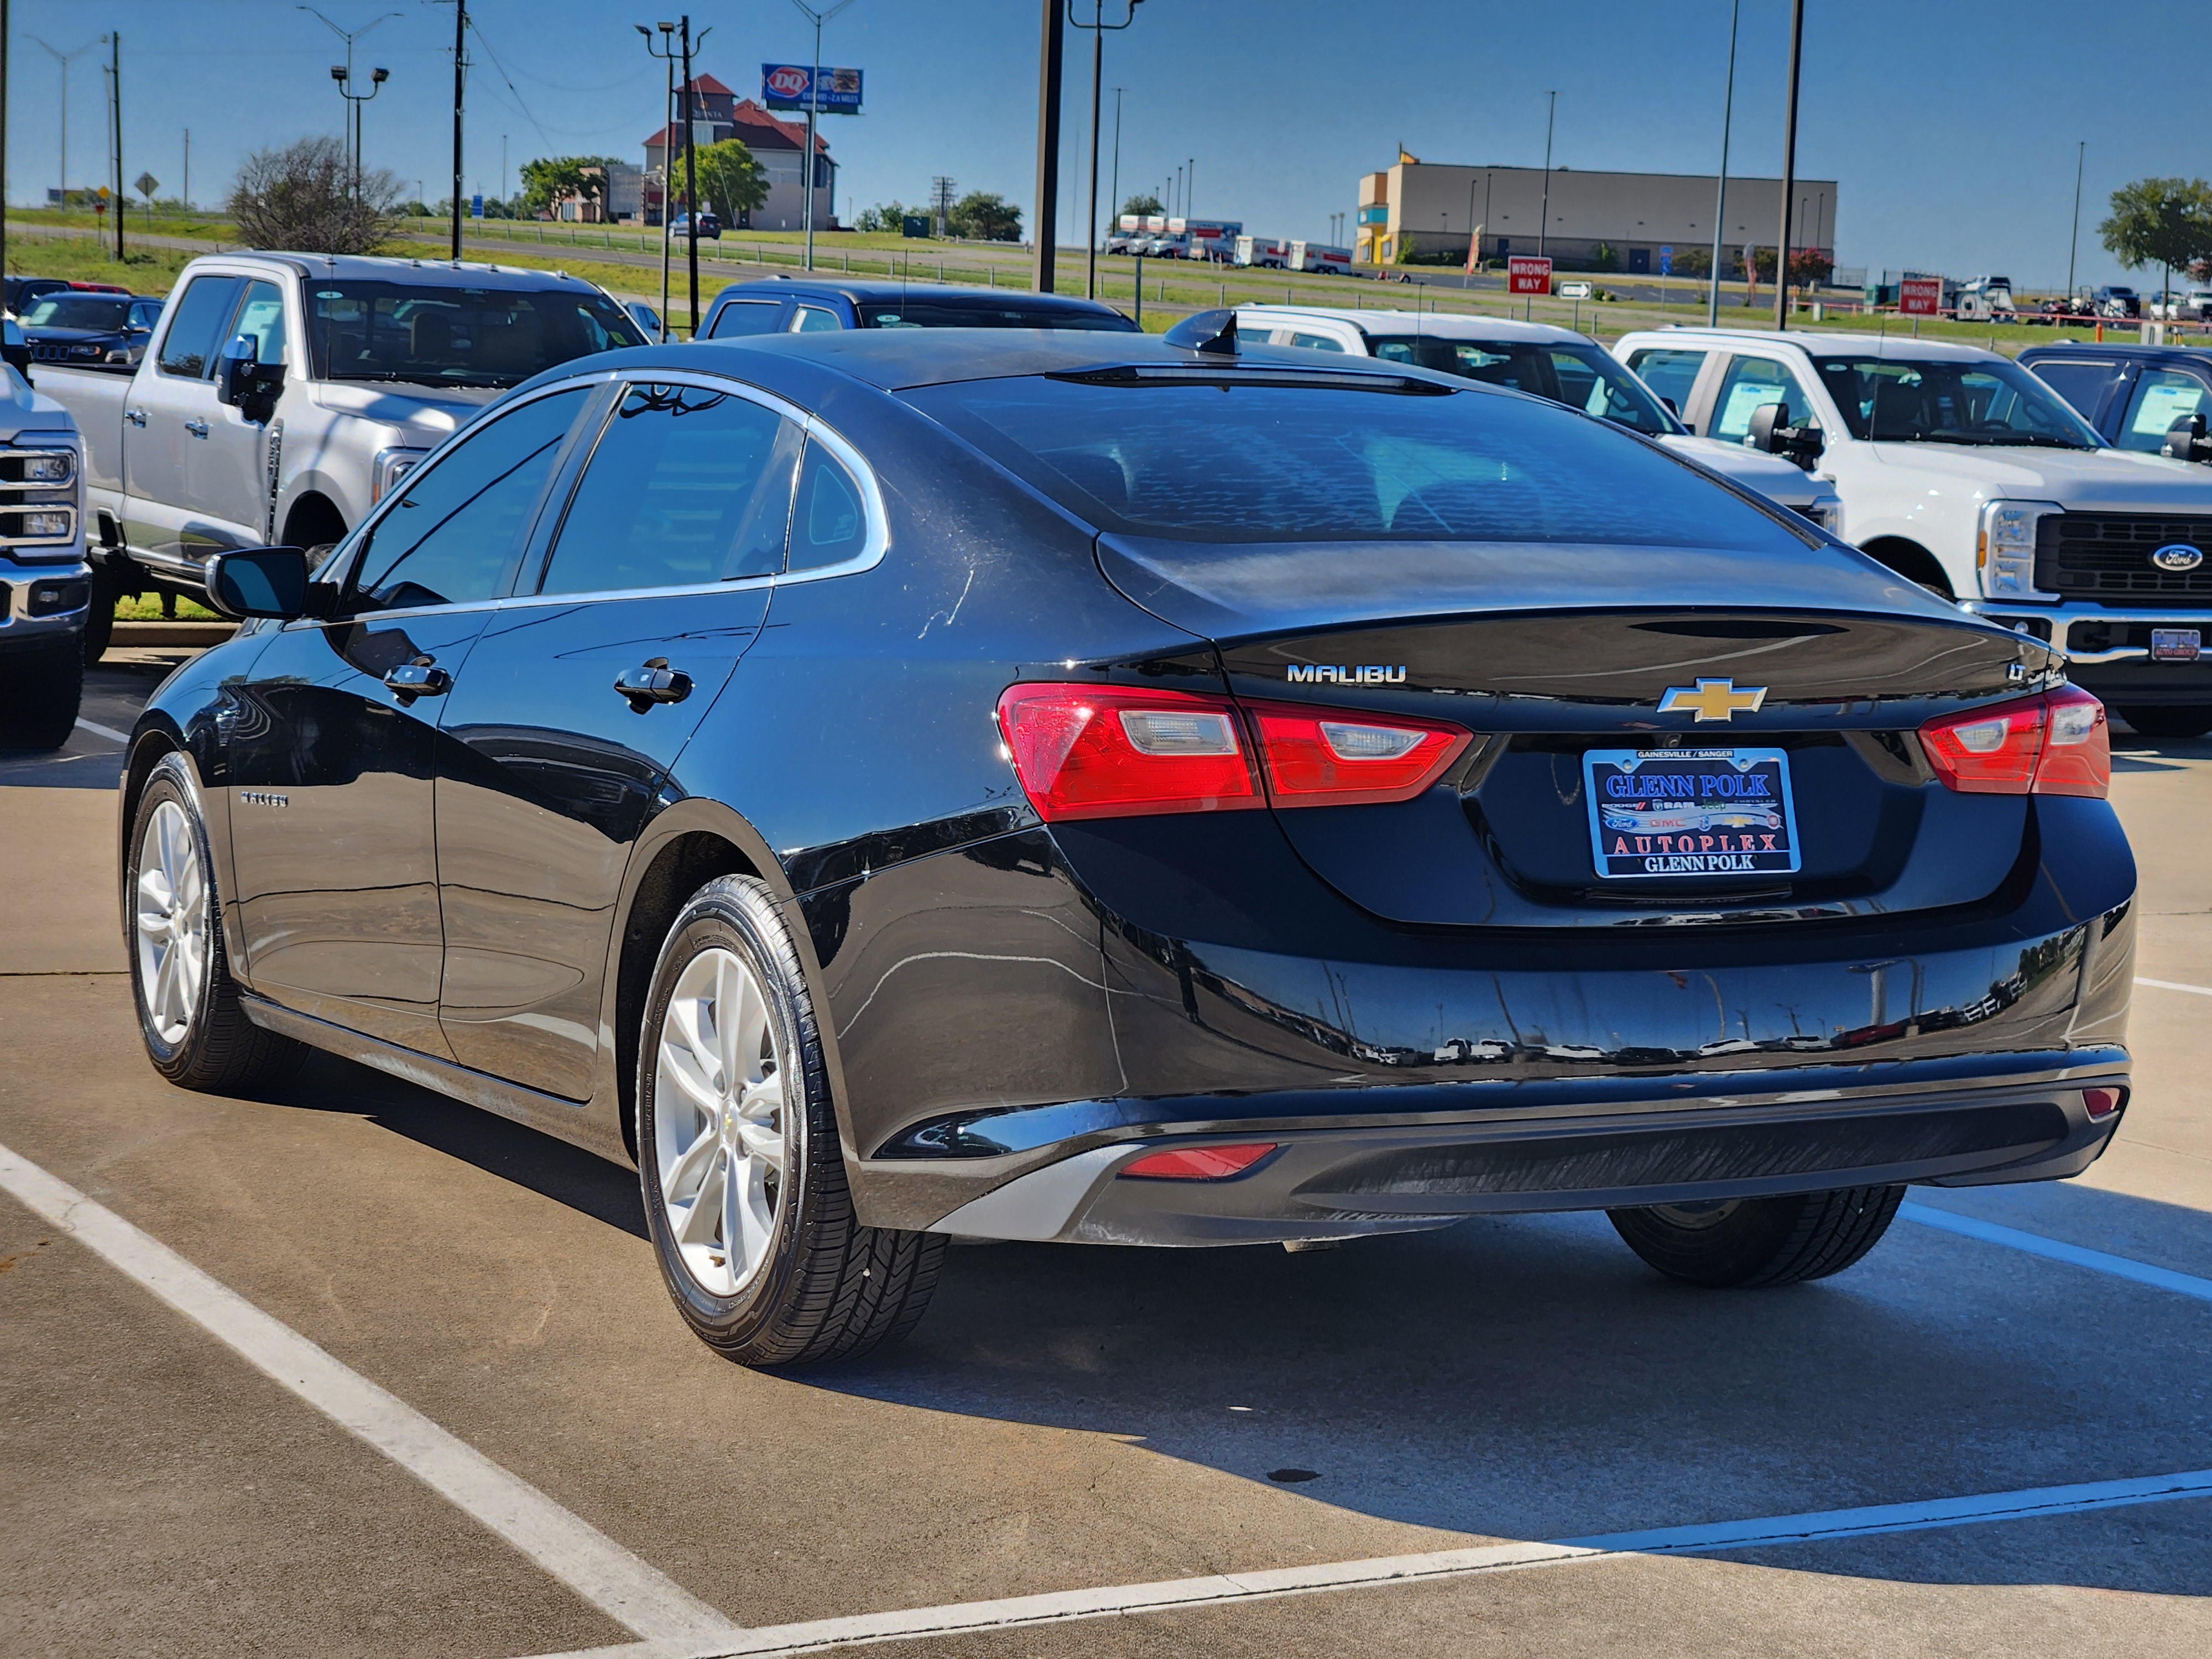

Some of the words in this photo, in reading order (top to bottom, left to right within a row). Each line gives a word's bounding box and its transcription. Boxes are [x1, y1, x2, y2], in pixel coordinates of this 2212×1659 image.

[775, 72, 803, 92] DQ
[1512, 262, 1549, 276] WRONG
[1518, 278, 1541, 290] WAY
[1903, 284, 1937, 298] WRONG
[1908, 299, 1930, 310] WAY
[2166, 549, 2193, 565] Ford
[1287, 664, 1407, 684] MALIBU
[2008, 663, 2026, 681] LT
[1606, 774, 1695, 797] GLENN
[1700, 774, 1771, 797] POLK
[1700, 799, 1726, 811] Jeep
[1611, 818, 1633, 828] Ford
[1650, 818, 1687, 827] GMC
[1614, 834, 1776, 854] AUTOPLEX
[1645, 856, 1704, 872] GLENN
[1708, 854, 1755, 872] POLK
